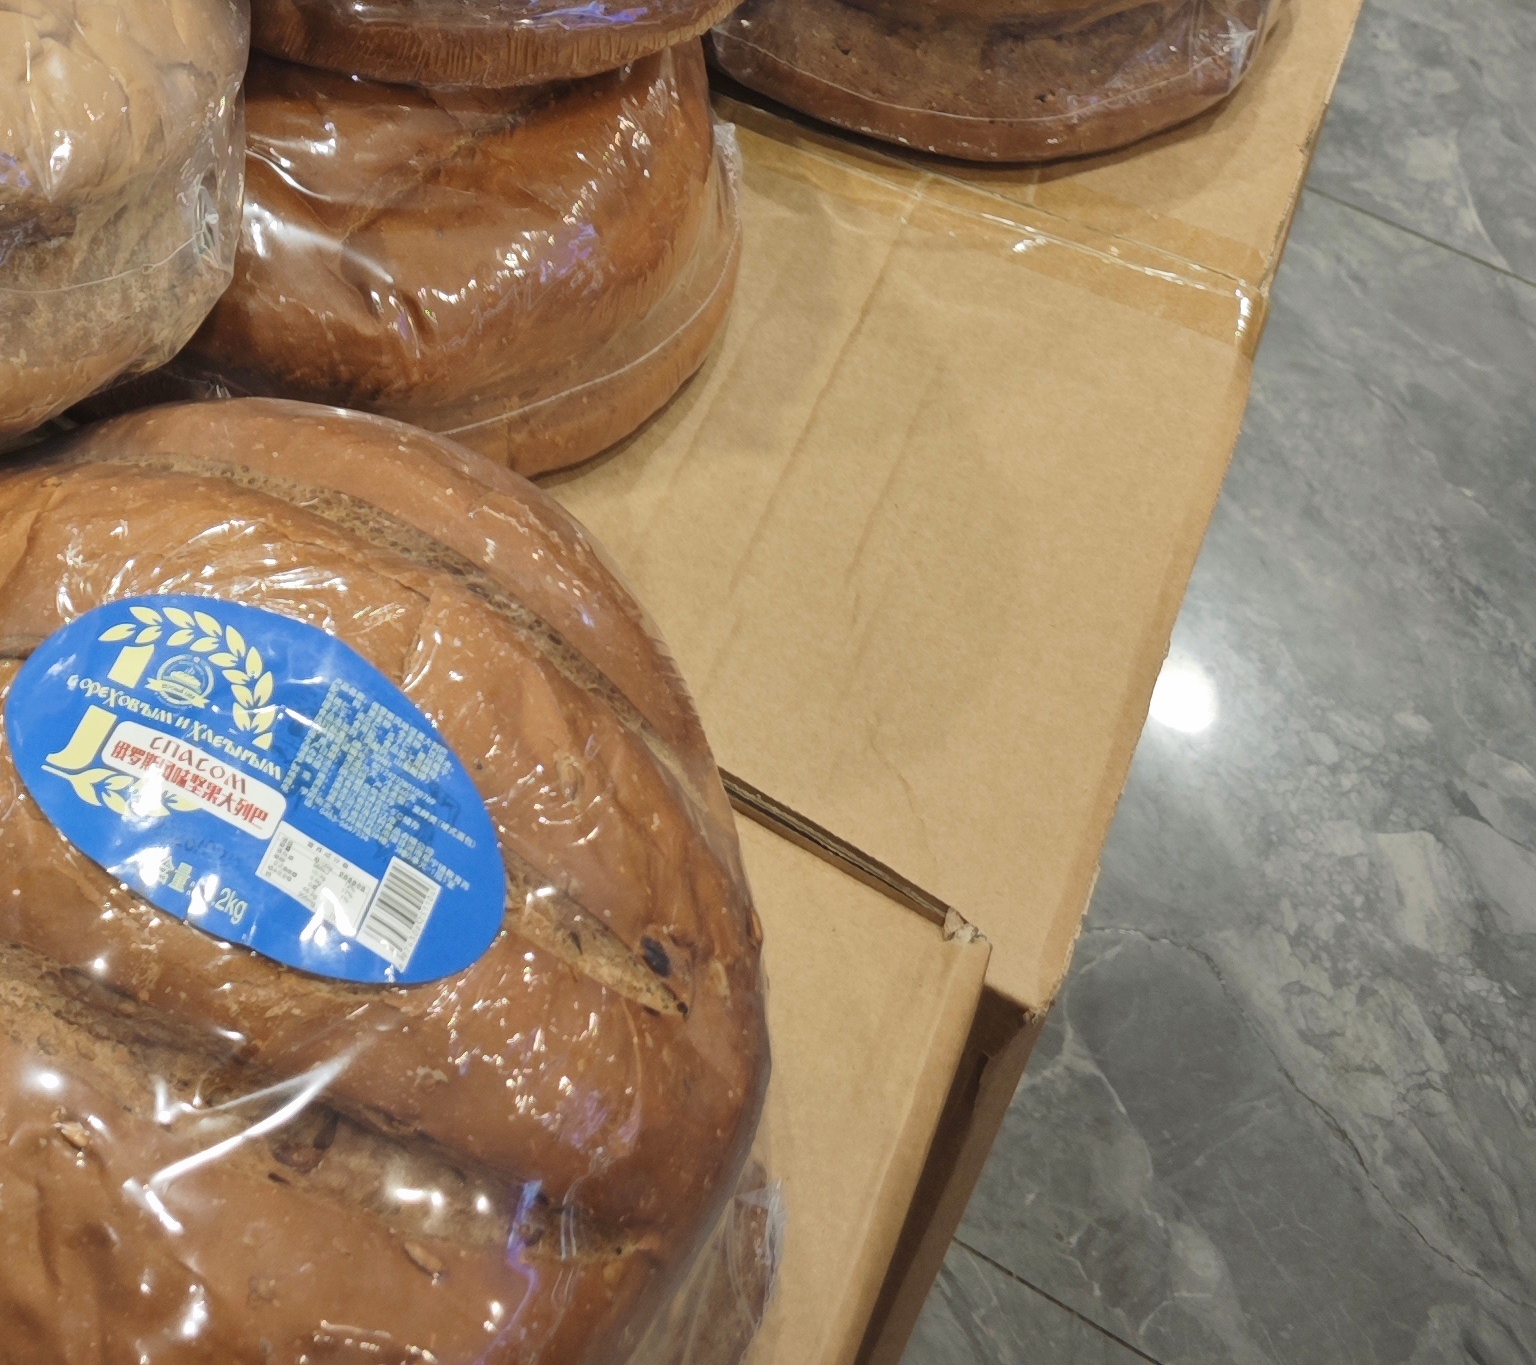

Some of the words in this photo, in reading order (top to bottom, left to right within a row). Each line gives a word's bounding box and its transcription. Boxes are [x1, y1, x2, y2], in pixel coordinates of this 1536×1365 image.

[110, 738, 270, 831] 俄罗斯风味坚果大列巴
